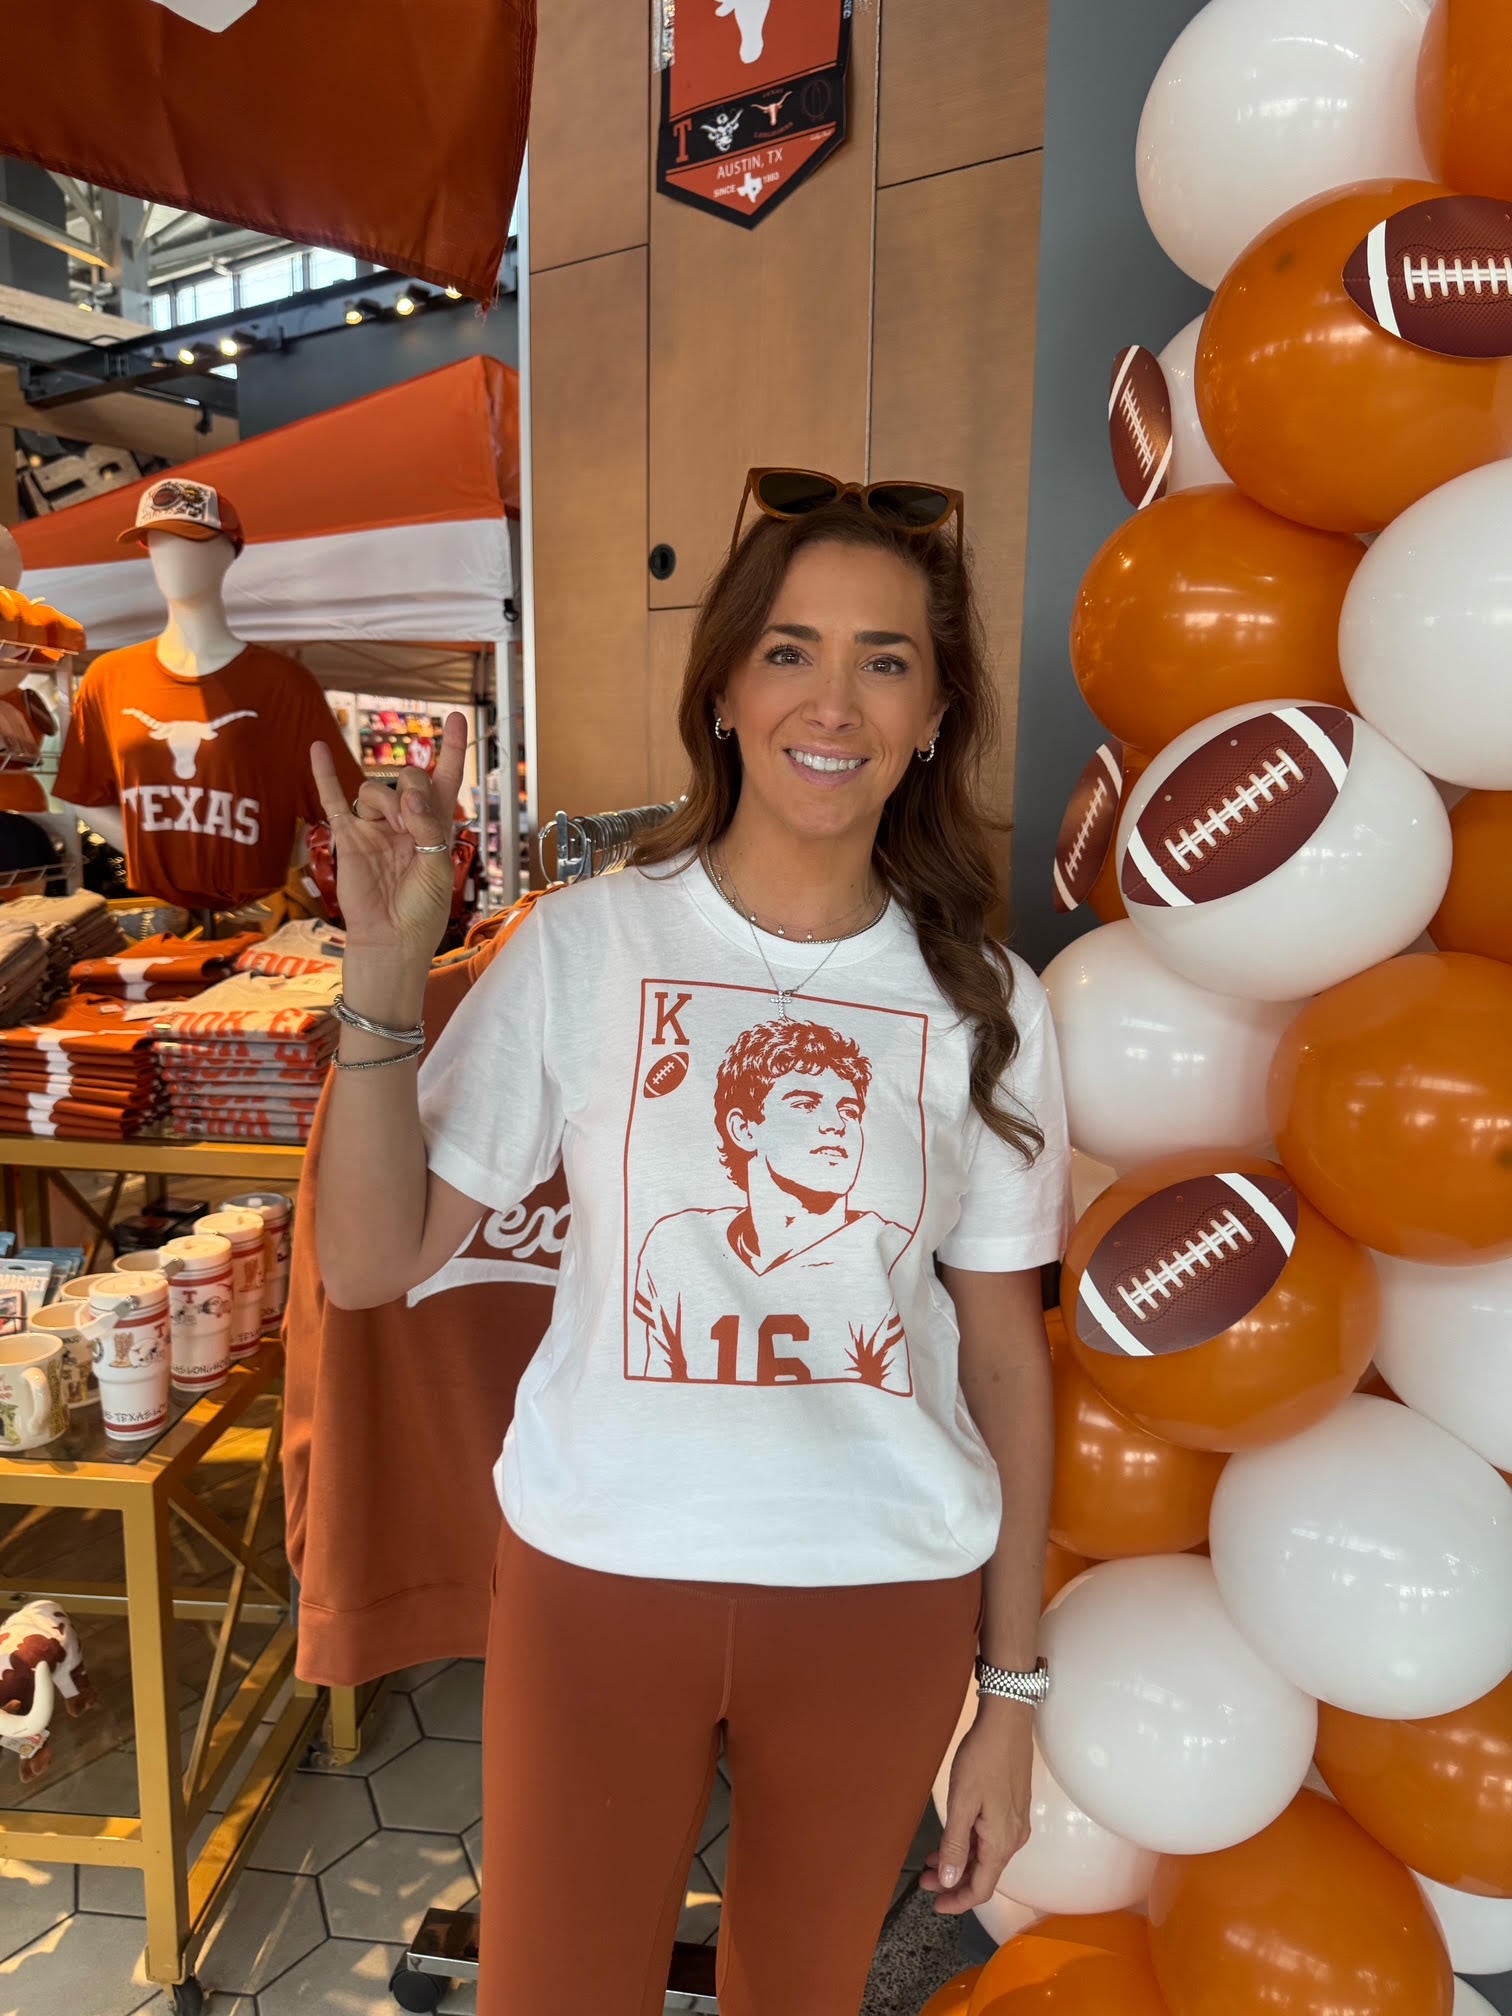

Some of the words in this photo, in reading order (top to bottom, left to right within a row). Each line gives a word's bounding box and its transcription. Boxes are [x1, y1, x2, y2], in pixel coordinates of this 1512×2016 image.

[716, 155, 765, 180] AUSTIN,
[767, 147, 784, 164] TX
[713, 184, 737, 198] SINCE
[652, 991, 693, 1046] K
[710, 1314, 812, 1386] 16
